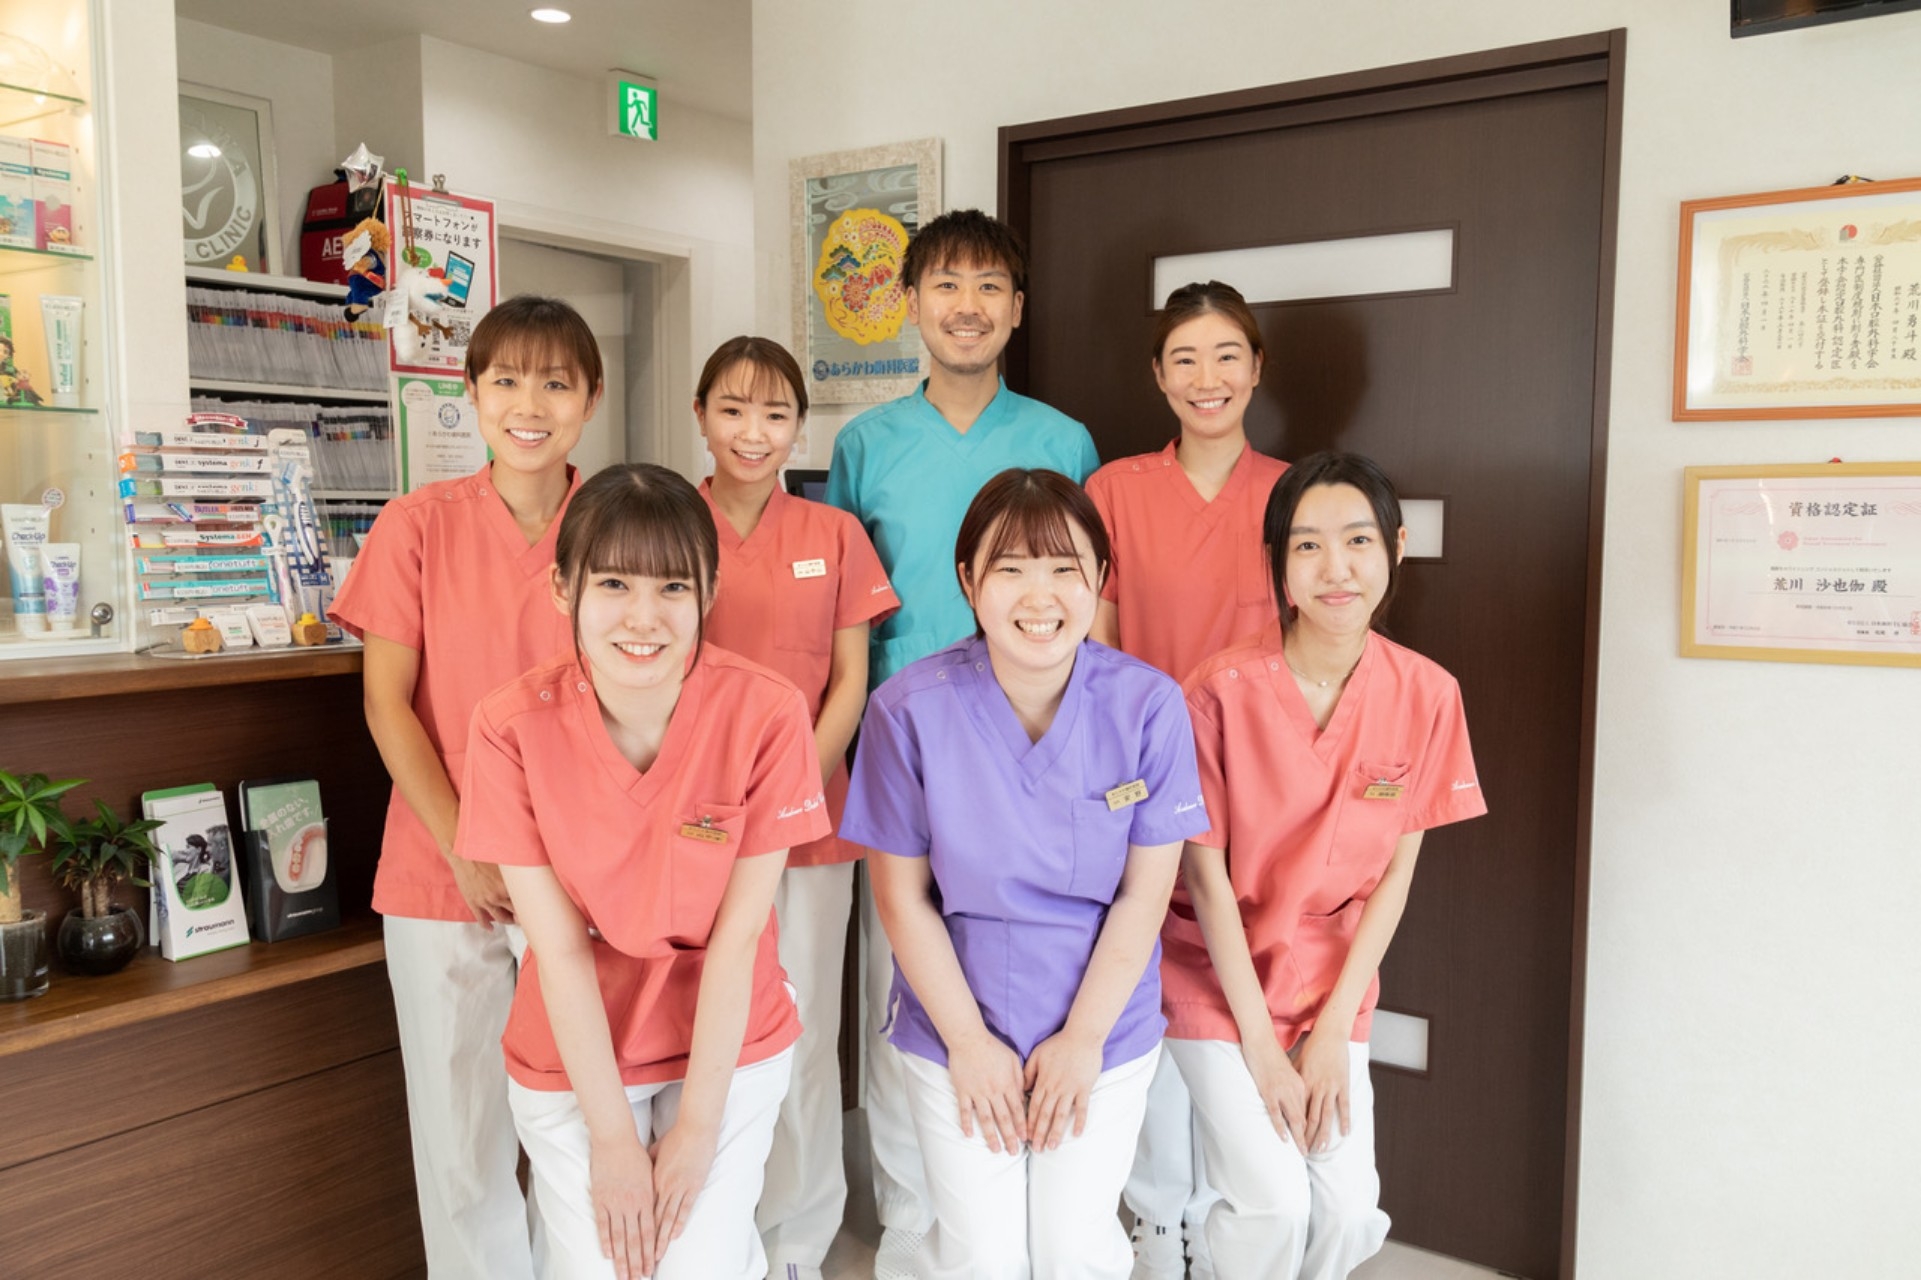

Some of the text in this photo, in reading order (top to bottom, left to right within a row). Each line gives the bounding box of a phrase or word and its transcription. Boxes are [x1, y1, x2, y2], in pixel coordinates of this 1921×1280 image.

[195, 205, 252, 259] CLINIC
[322, 236, 344, 257] AE
[1788, 502, 1879, 517] 資格認定証
